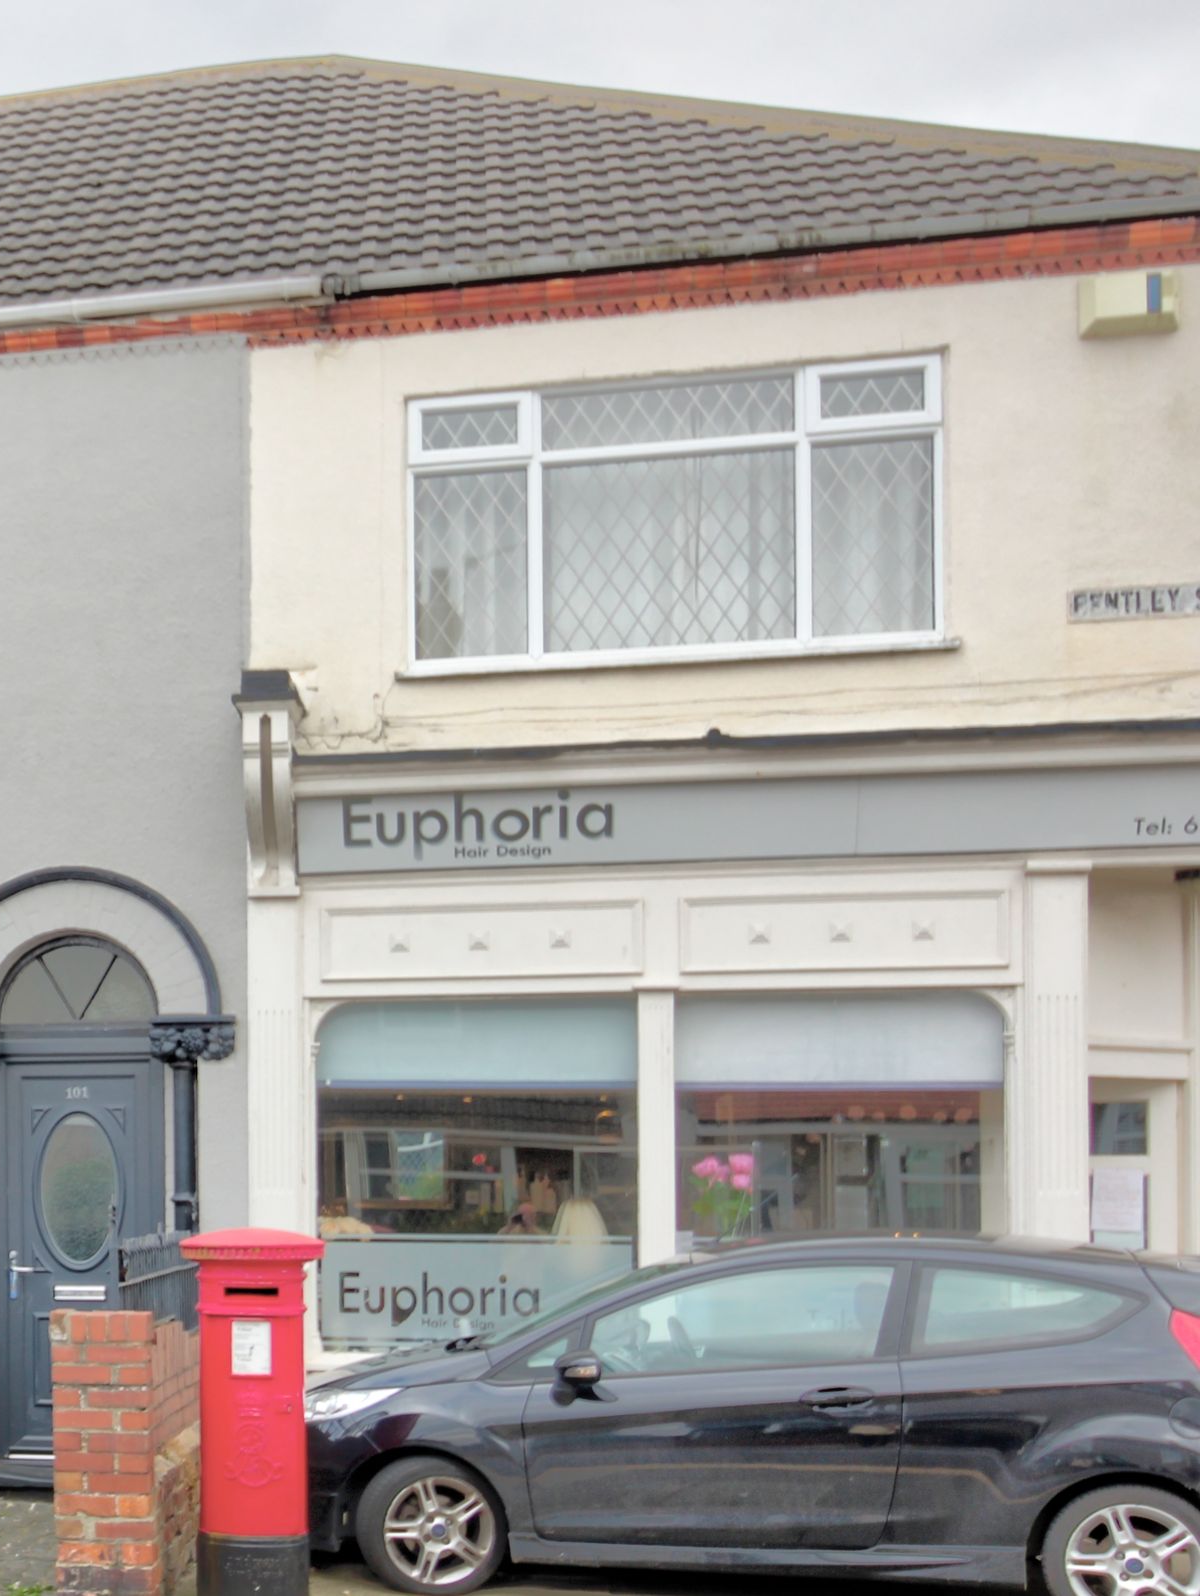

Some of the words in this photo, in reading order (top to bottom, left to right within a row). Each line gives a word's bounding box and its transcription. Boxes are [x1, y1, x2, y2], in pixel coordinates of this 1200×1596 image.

[342, 789, 614, 860] Euphoria
[1133, 816, 1172, 836] Tel:
[454, 846, 489, 859] Hair
[496, 844, 553, 859] Design
[64, 1086, 89, 1100] 101
[339, 1271, 541, 1328] Euphoria
[421, 1318, 448, 1329] Hair
[453, 1317, 495, 1331] Dsign
